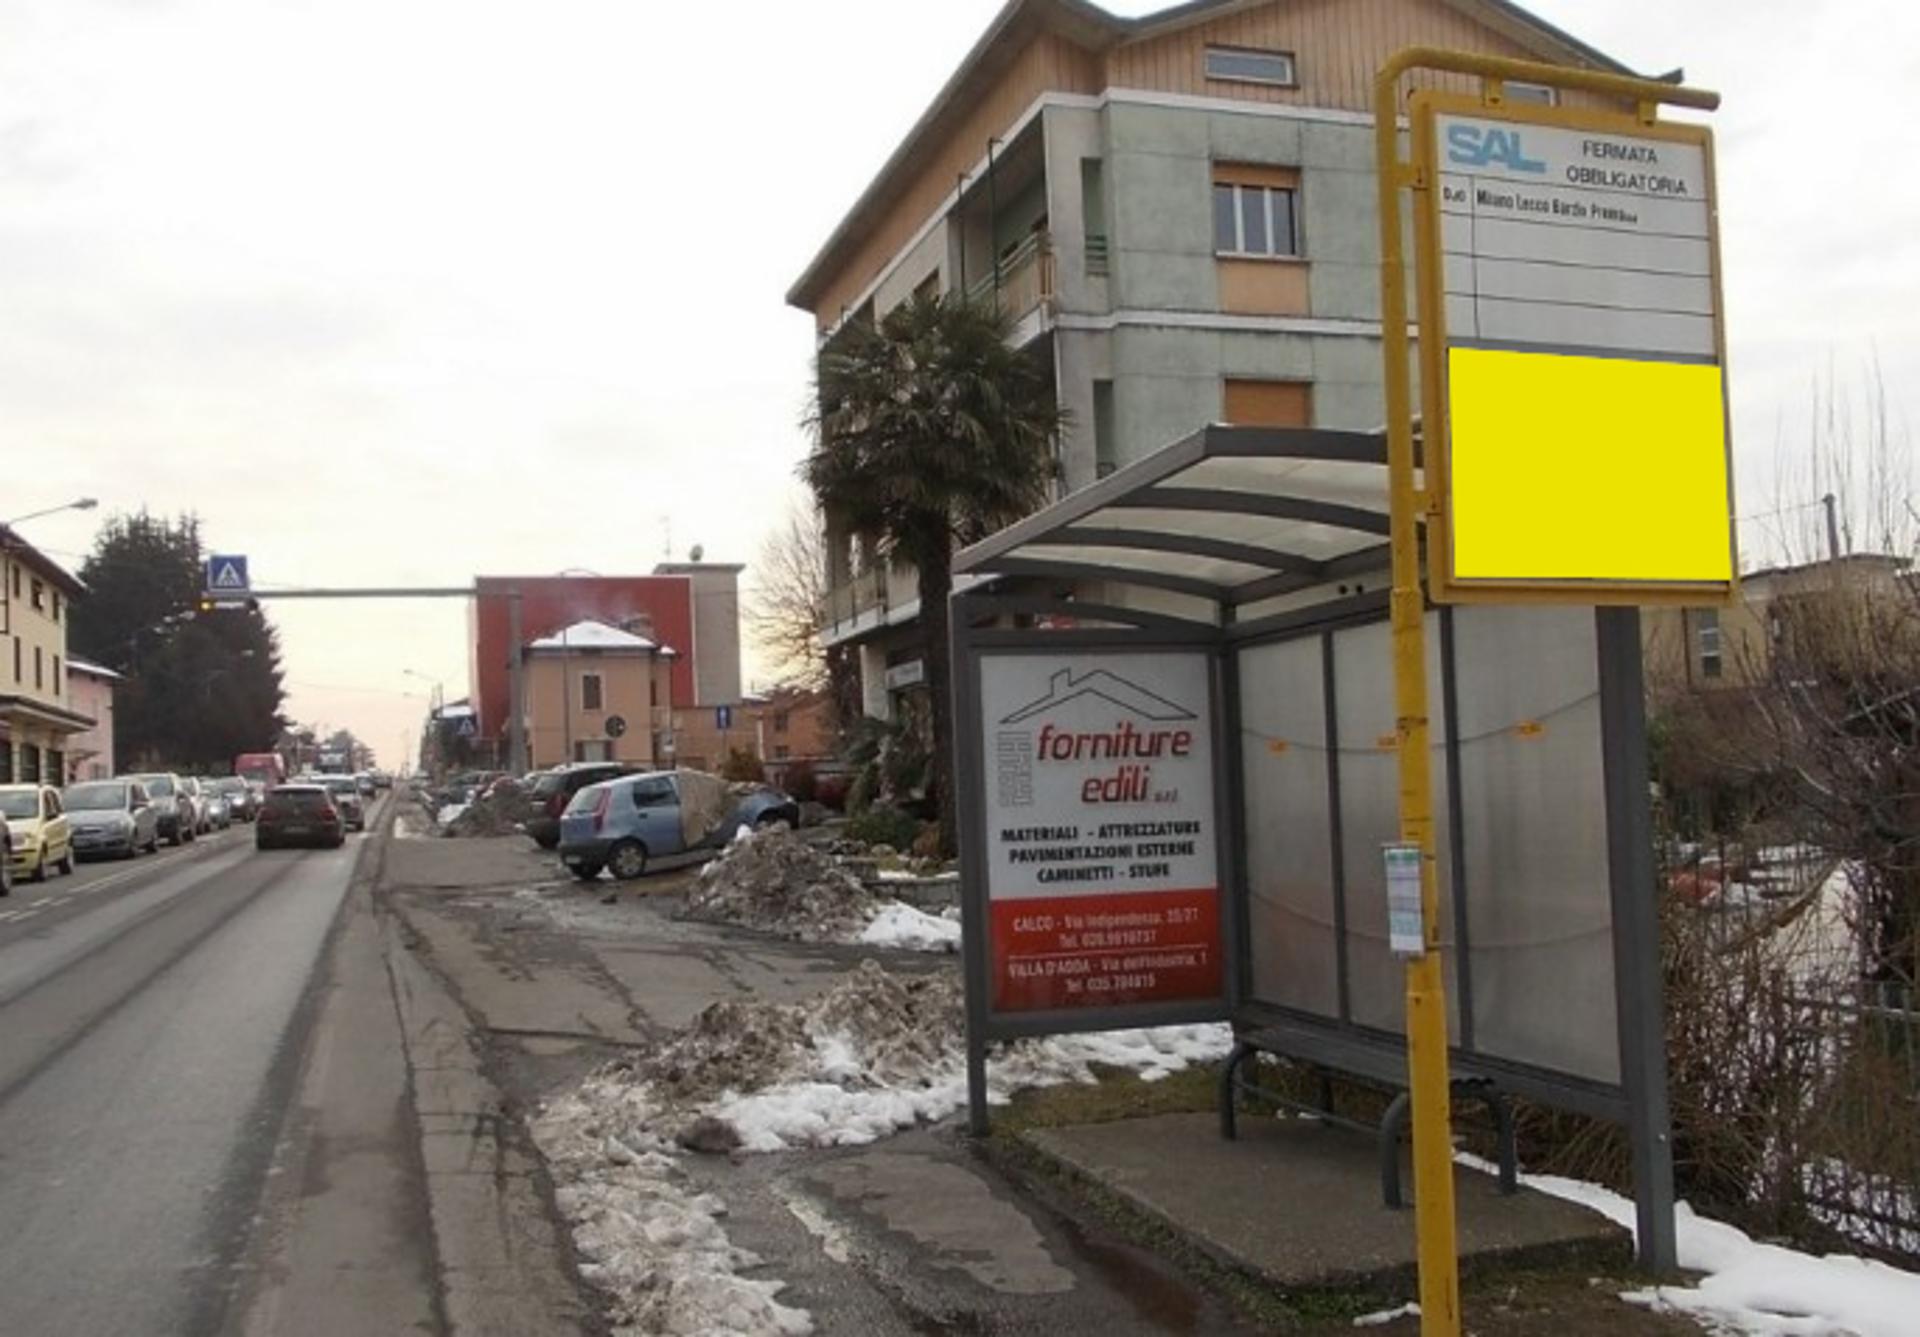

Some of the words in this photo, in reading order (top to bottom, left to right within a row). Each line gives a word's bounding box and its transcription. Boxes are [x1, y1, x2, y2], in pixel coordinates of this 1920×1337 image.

[1448, 125, 1546, 173] SAL
[1582, 139, 1658, 165] FERMATA
[1565, 165, 1688, 196] OBBLIGATORIA
[1476, 189, 1514, 209] Milano
[1516, 194, 1549, 213] Lecco
[1038, 721, 1192, 760] forniture
[1081, 765, 1151, 804] edili
[1001, 826, 1079, 843] MATERIALI
[1097, 820, 1201, 840] ATTREZZATURE
[1009, 844, 1134, 864] PAVIMENTAZIONI
[1136, 841, 1196, 859] ESTERNE
[1037, 865, 1115, 884] CAMINETTI
[1128, 862, 1170, 879] STUFE
[1013, 915, 1055, 933] CALCO
[1065, 914, 1084, 931] Via
[1008, 961, 1045, 979] VILLA
[1101, 956, 1121, 972] Via
